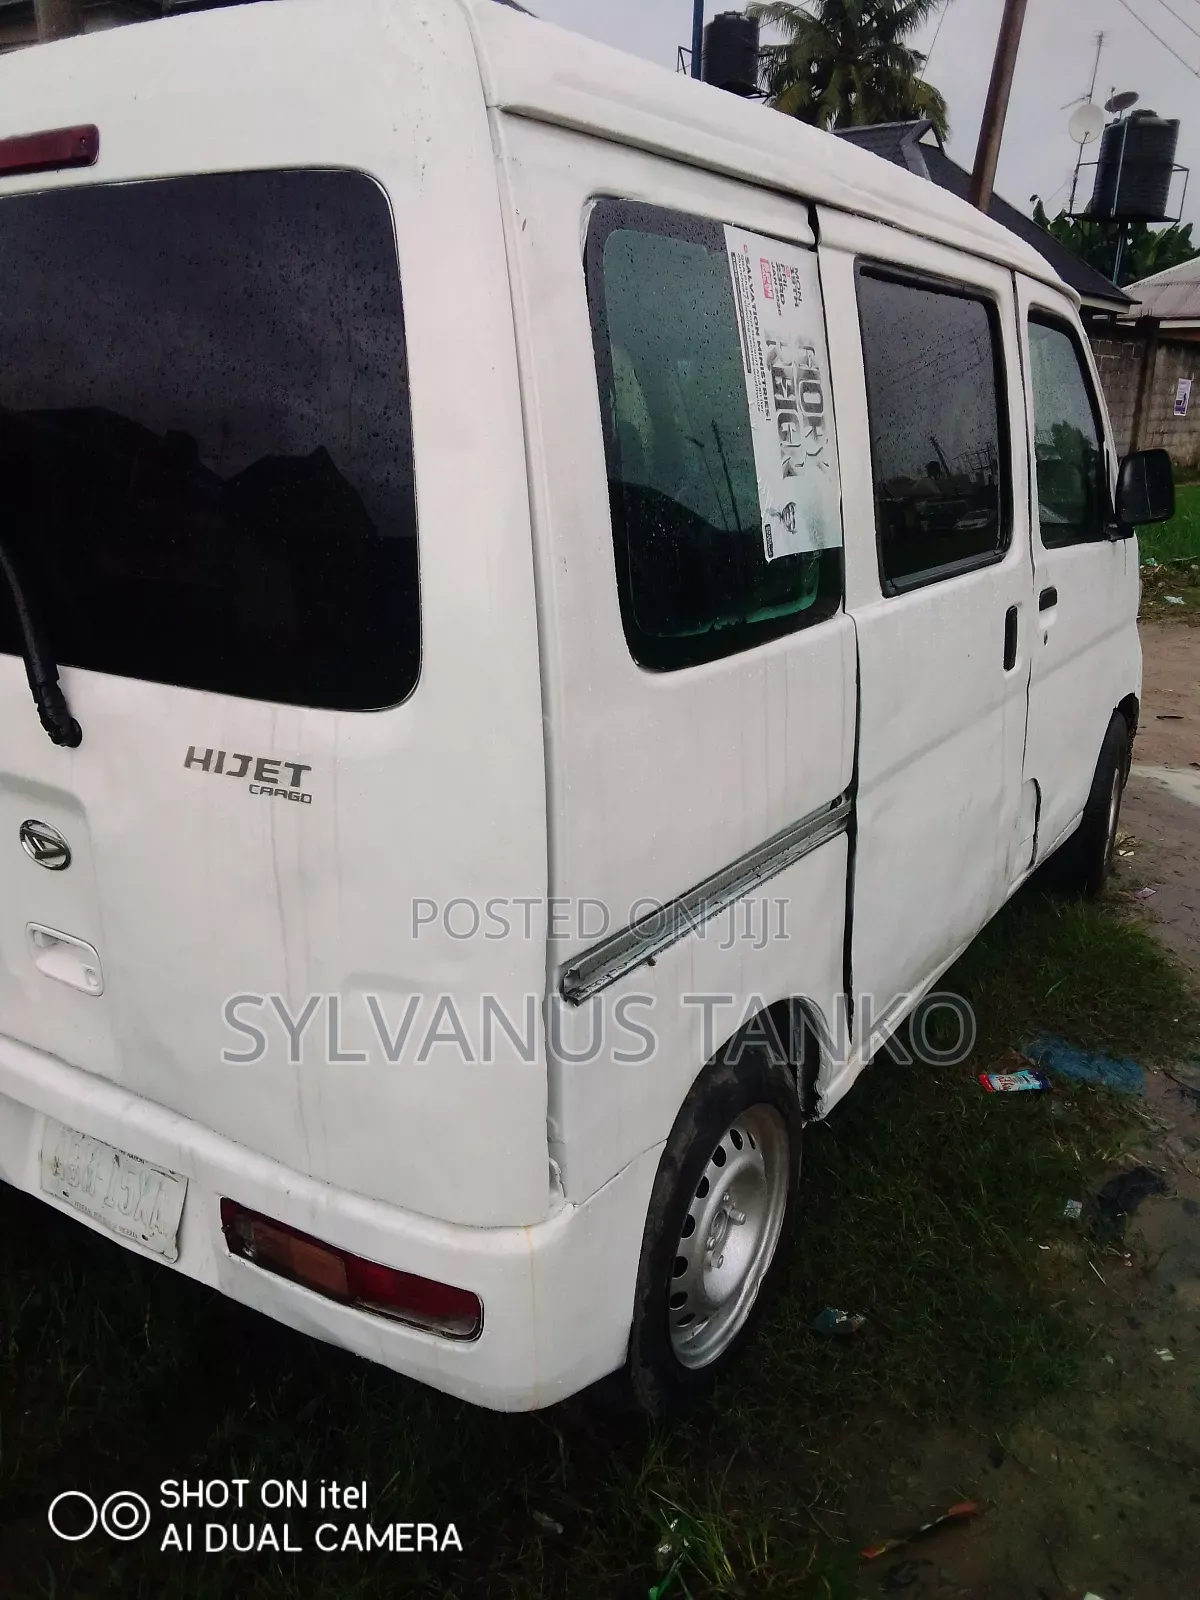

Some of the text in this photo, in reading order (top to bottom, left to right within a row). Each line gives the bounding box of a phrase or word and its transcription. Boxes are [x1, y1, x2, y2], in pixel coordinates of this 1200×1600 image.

[746, 256, 760, 336] SALVATION
[183, 745, 312, 787] HIJET
[249, 783, 312, 804] CARGO
